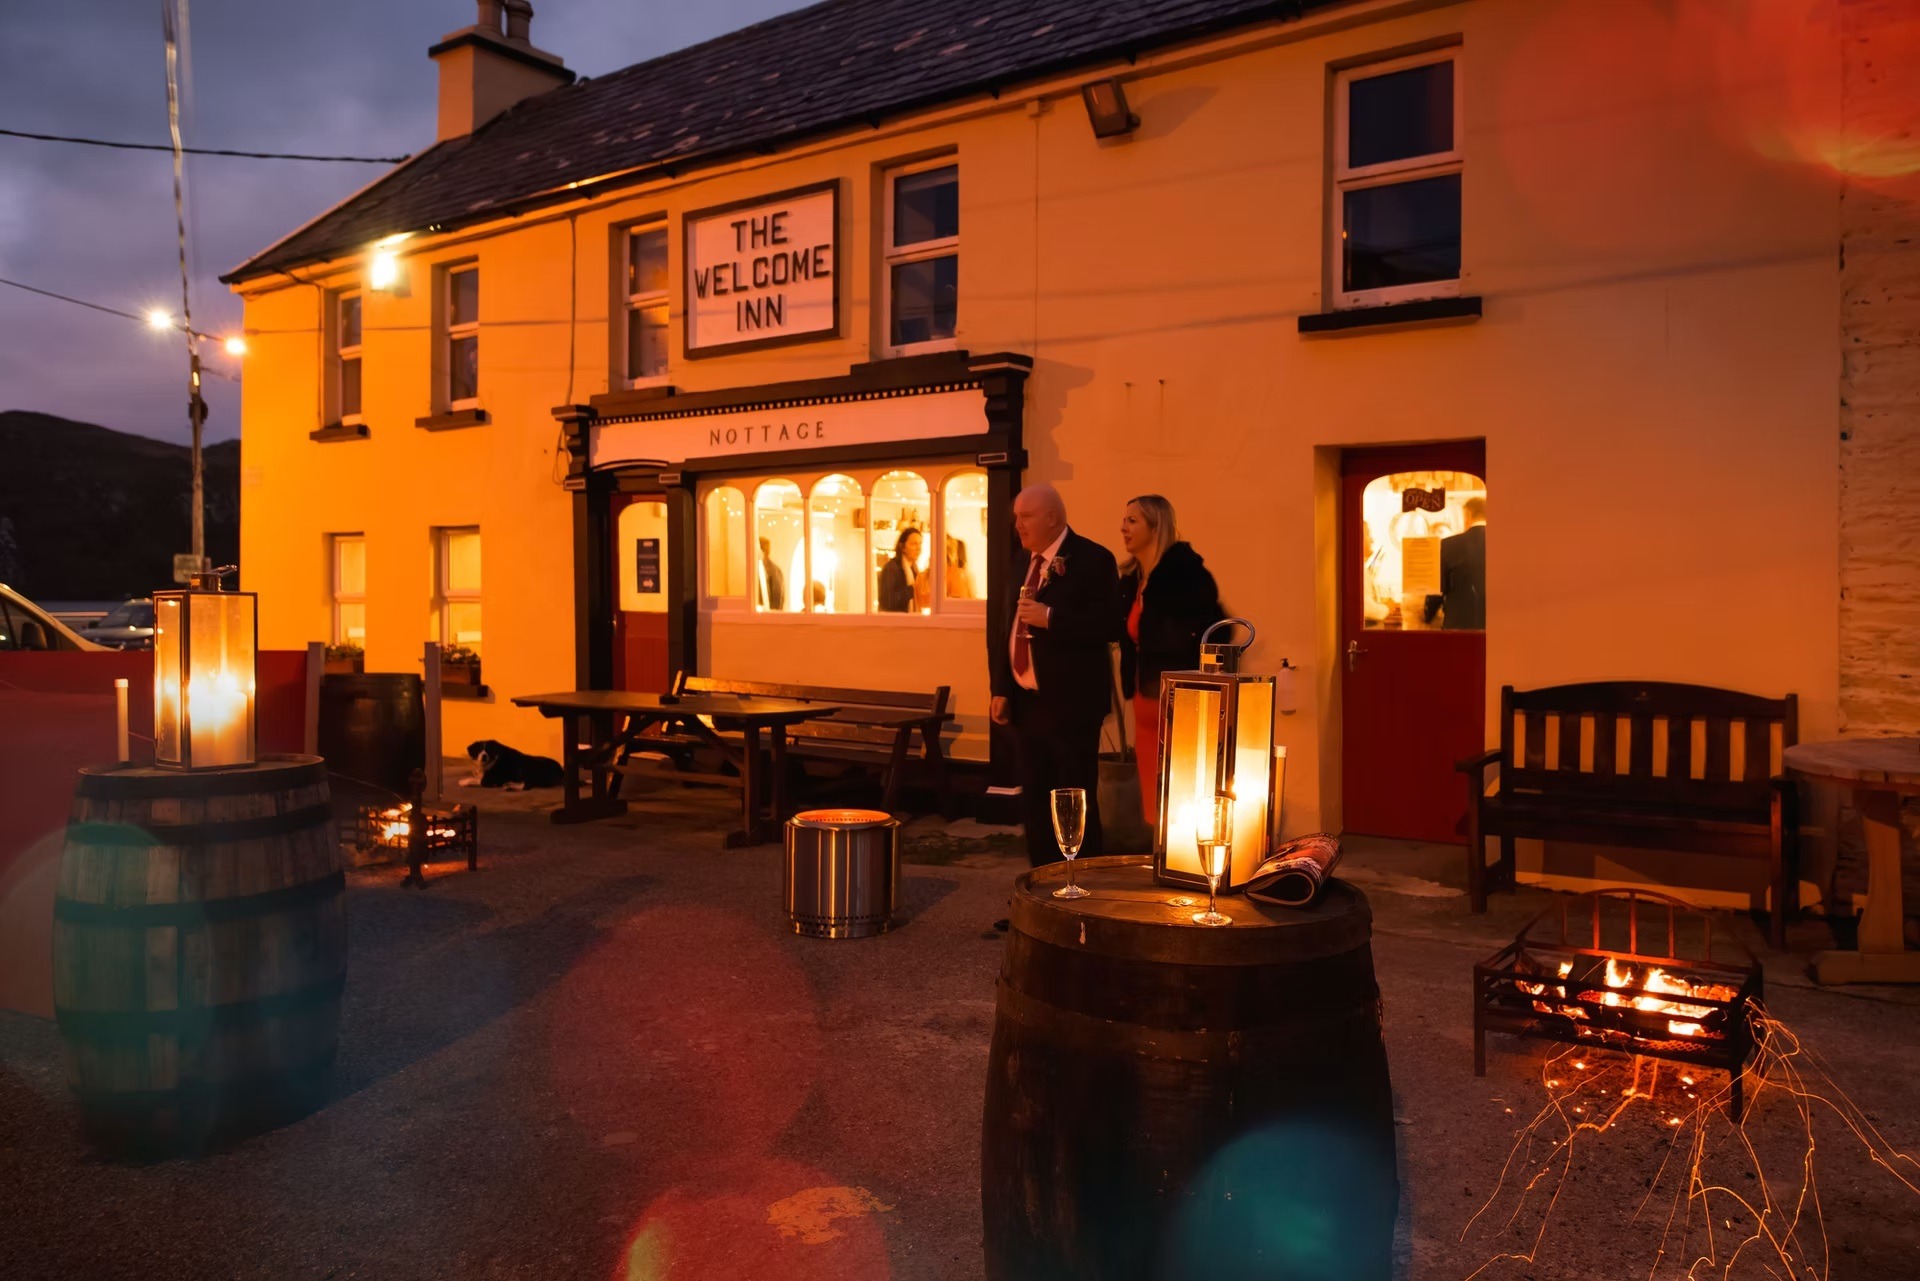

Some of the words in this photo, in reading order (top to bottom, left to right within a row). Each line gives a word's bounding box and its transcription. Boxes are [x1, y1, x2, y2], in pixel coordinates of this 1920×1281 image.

[730, 211, 788, 252] THE
[694, 244, 830, 299] WELCOME
[736, 294, 783, 332] INN
[709, 421, 824, 446] NOTTAGE
[1405, 493, 1441, 510] OPEN
